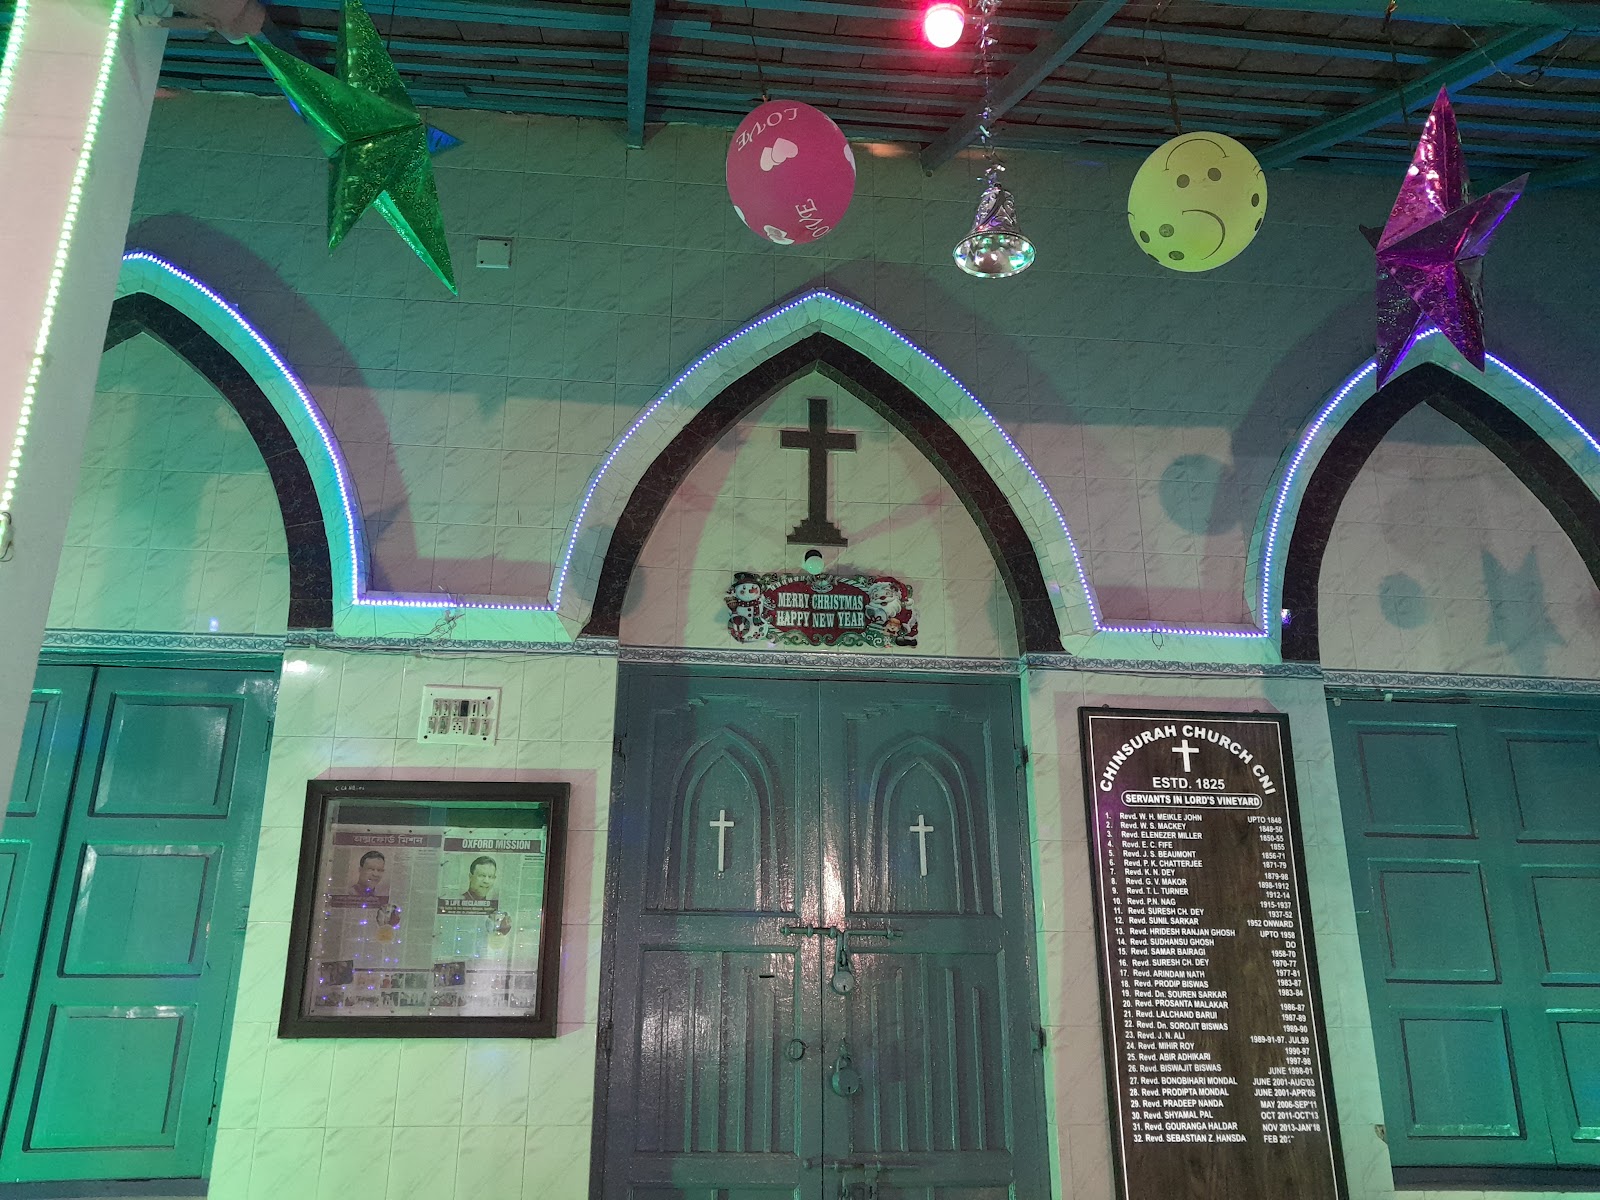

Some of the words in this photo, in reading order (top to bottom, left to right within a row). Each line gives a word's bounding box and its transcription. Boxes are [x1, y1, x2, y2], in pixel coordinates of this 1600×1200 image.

[736, 107, 798, 152] LOVE
[795, 198, 832, 238] OVE
[778, 593, 810, 608] MERRY
[811, 594, 863, 611] CHRISTMAS
[776, 610, 811, 627] HAPPY
[812, 613, 835, 628] NEW
[838, 612, 865, 628] YEAR
[1100, 725, 1177, 792] CHINSURAH
[1182, 725, 1253, 764] CHURCH
[1253, 764, 1276, 795] CNI
[1152, 777, 1192, 789] ESTD.
[1196, 778, 1225, 790] 1825
[1125, 794, 1171, 804] SERVANTS
[1173, 795, 1182, 804] IN
[1184, 796, 1215, 805] LORD'S
[1216, 796, 1260, 806] VINEYARD
[1183, 813, 1202, 821] JOHN
[1247, 815, 1266, 823] UPTO
[398, 834, 423, 844] মিশন
[1121, 830, 1139, 838] Revd.
[1177, 831, 1202, 839] MILLER
[462, 839, 494, 849] OXFORD
[495, 840, 530, 850] MISSION
[1121, 840, 1140, 848] Revd.
[1122, 849, 1141, 857] Revd.
[1157, 850, 1196, 858] BEAUMONT
[1158, 859, 1202, 867] CHATTERJEE
[1161, 868, 1175, 876] DEY
[1126, 886, 1145, 894] Revd.
[1160, 887, 1189, 895] TURNER
[1127, 906, 1146, 914] Revd.
[1128, 916, 1147, 924] Revd.
[1262, 919, 1294, 928] ONWARD
[1149, 927, 1180, 935] HRIDESH
[1210, 928, 1235, 936] GHOSH
[1259, 930, 1279, 938] UPTO
[1189, 938, 1214, 946] GHOSH
[1130, 947, 1149, 955] Revd.
[1131, 958, 1151, 966] Revd.
[1151, 958, 1180, 966] SURESH
[1194, 958, 1209, 966] DEY
[1132, 968, 1151, 977] Revd.
[1133, 979, 1152, 987] Revd.
[1181, 980, 1209, 988] BISWAS
[1134, 989, 1153, 997] Revd.
[1167, 990, 1196, 998] SOUREN
[1198, 990, 1227, 998] SARKAR
[1134, 999, 1154, 1007] Revd.
[1154, 999, 1193, 1007] PROSANTA
[1194, 1000, 1228, 1009] MALAKAR
[1135, 1009, 1154, 1017] Revd.
[1155, 1010, 1194, 1018] LALCHAND
[1195, 1011, 1217, 1019] BARUI
[1136, 1020, 1155, 1028] Revd.
[1169, 1022, 1200, 1030] SOROJIT
[1200, 1022, 1228, 1030] BISWAS
[1136, 1031, 1156, 1039] Revd.
[1177, 1052, 1211, 1060] ADHIKARI
[1139, 1064, 1158, 1072] Revd.
[1159, 1064, 1192, 1072] BISWAJIT
[1193, 1063, 1222, 1071] BISWAS
[1267, 1066, 1286, 1074] JUNE
[1140, 1076, 1160, 1084] Revd.
[1160, 1076, 1206, 1084] BONOBIHARI
[1206, 1076, 1238, 1084] MONDAL
[1252, 1077, 1271, 1085] JUNE
[1141, 1088, 1160, 1096] Revd.
[1198, 1088, 1229, 1096] MONDAL
[1253, 1088, 1273, 1096] JUNE
[1142, 1099, 1162, 1107] Revd.
[1162, 1099, 1197, 1107] PRADEEP
[1198, 1099, 1224, 1107] NANDA
[1260, 1100, 1275, 1108] MAY
[1143, 1111, 1163, 1119] Revd.
[1163, 1110, 1198, 1119] SHYAMAL
[1199, 1110, 1213, 1118] PAL
[1260, 1111, 1276, 1119] OCT
[1144, 1122, 1164, 1130] Revd.
[1164, 1122, 1207, 1130] GOURANGA
[1207, 1121, 1238, 1130] HALDAR
[1262, 1123, 1278, 1131] NOV
[1144, 1133, 1164, 1142] Revd.
[1165, 1134, 1207, 1142] SEBASTIAN
[1215, 1134, 1247, 1142] HANSDA
[1263, 1134, 1278, 1143] FEB
